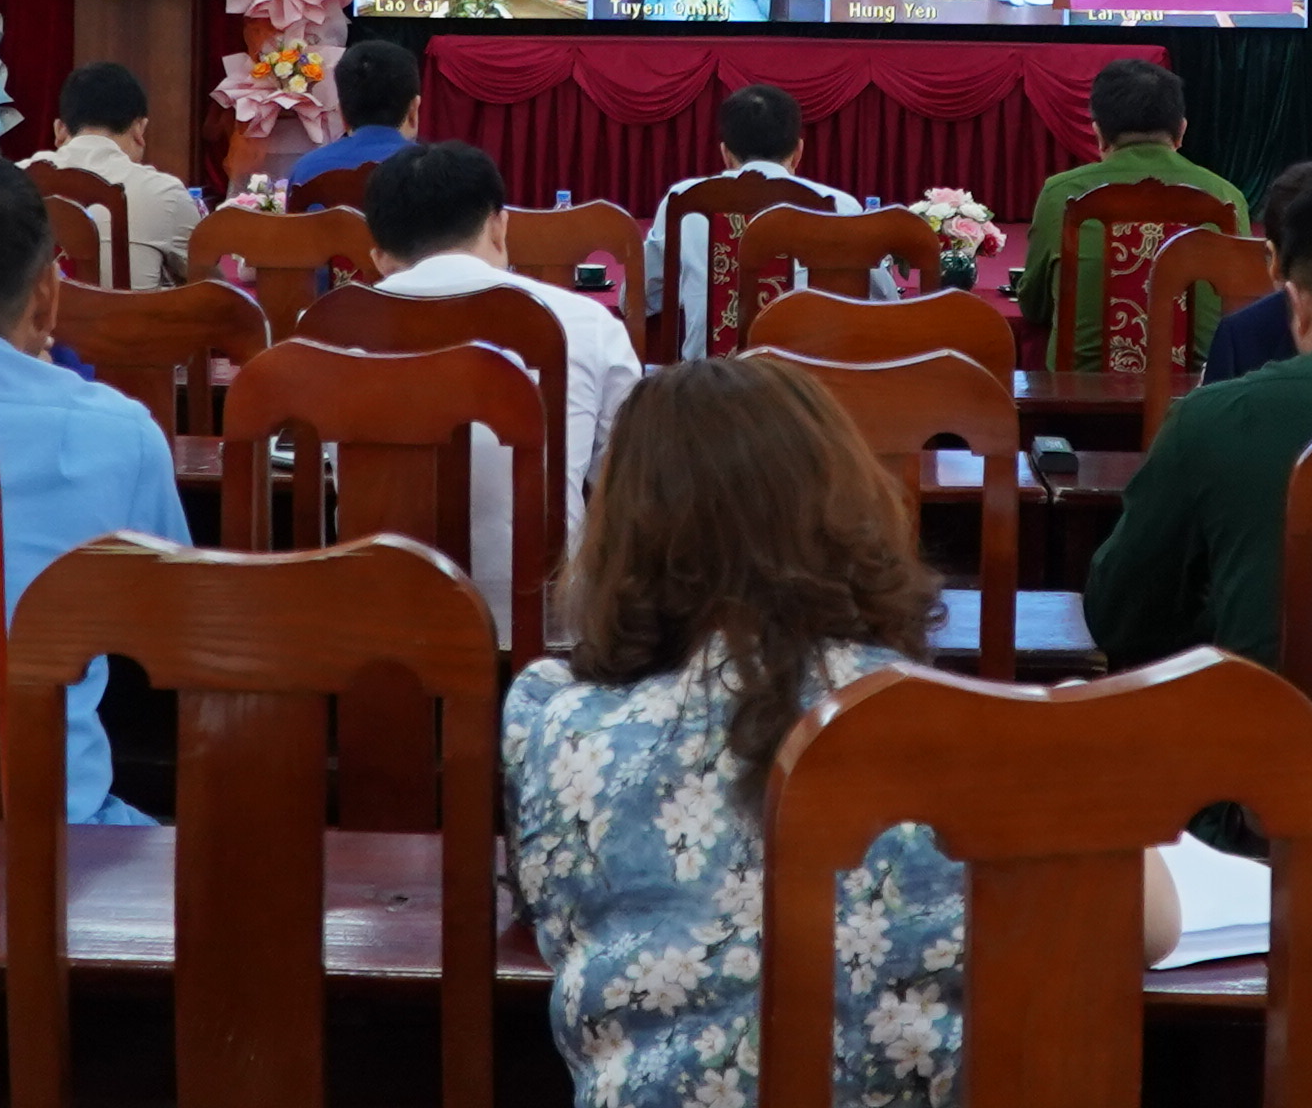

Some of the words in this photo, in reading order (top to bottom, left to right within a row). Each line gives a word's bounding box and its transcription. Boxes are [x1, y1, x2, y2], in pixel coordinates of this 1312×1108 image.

[673, 0, 730, 22] Quang
[848, 2, 896, 23] Hung
[904, 2, 937, 20] Yen
